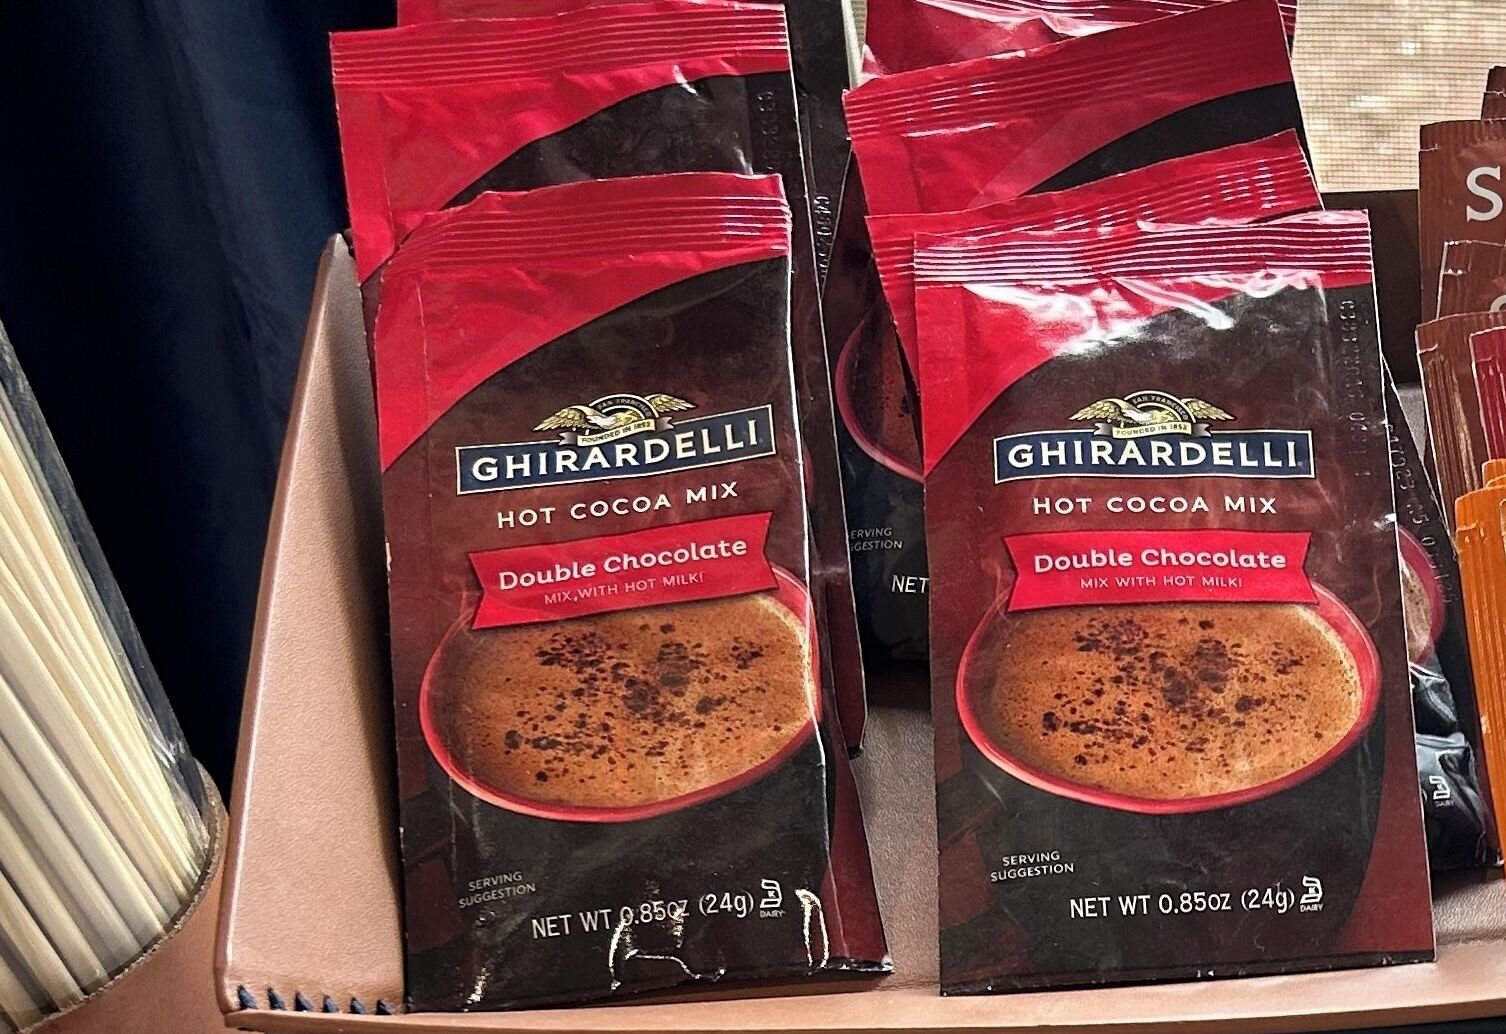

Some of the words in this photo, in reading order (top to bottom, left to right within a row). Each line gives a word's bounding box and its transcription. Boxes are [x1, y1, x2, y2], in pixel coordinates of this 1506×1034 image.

[471, 419, 758, 482] GHIRARDELLI
[1007, 441, 1298, 468] GHIRARDELLI
[497, 507, 556, 528] HOT
[571, 494, 671, 520] COCOA
[686, 482, 738, 504] MIX
[1033, 498, 1092, 515] HOT
[1106, 496, 1209, 513] COCOA
[1224, 496, 1277, 514] MIX
[498, 561, 596, 591] Double
[604, 540, 747, 573] Chocolate
[1034, 548, 1133, 574] Double
[1141, 548, 1286, 569] Chocolate
[892, 575, 930, 593] NET
[1080, 577, 1109, 589] MIX
[1116, 576, 1156, 588] WITH
[1163, 576, 1195, 587] HOT
[1002, 850, 1061, 867] SERVING
[469, 871, 523, 892] SERVING
[990, 862, 1074, 883] SUGGESTION
[458, 882, 536, 908] SUGGESTION
[1070, 896, 1110, 919] NET
[1118, 894, 1151, 915] WT
[1158, 892, 1231, 915] 0.85oz
[1241, 886, 1295, 914] (24g)
